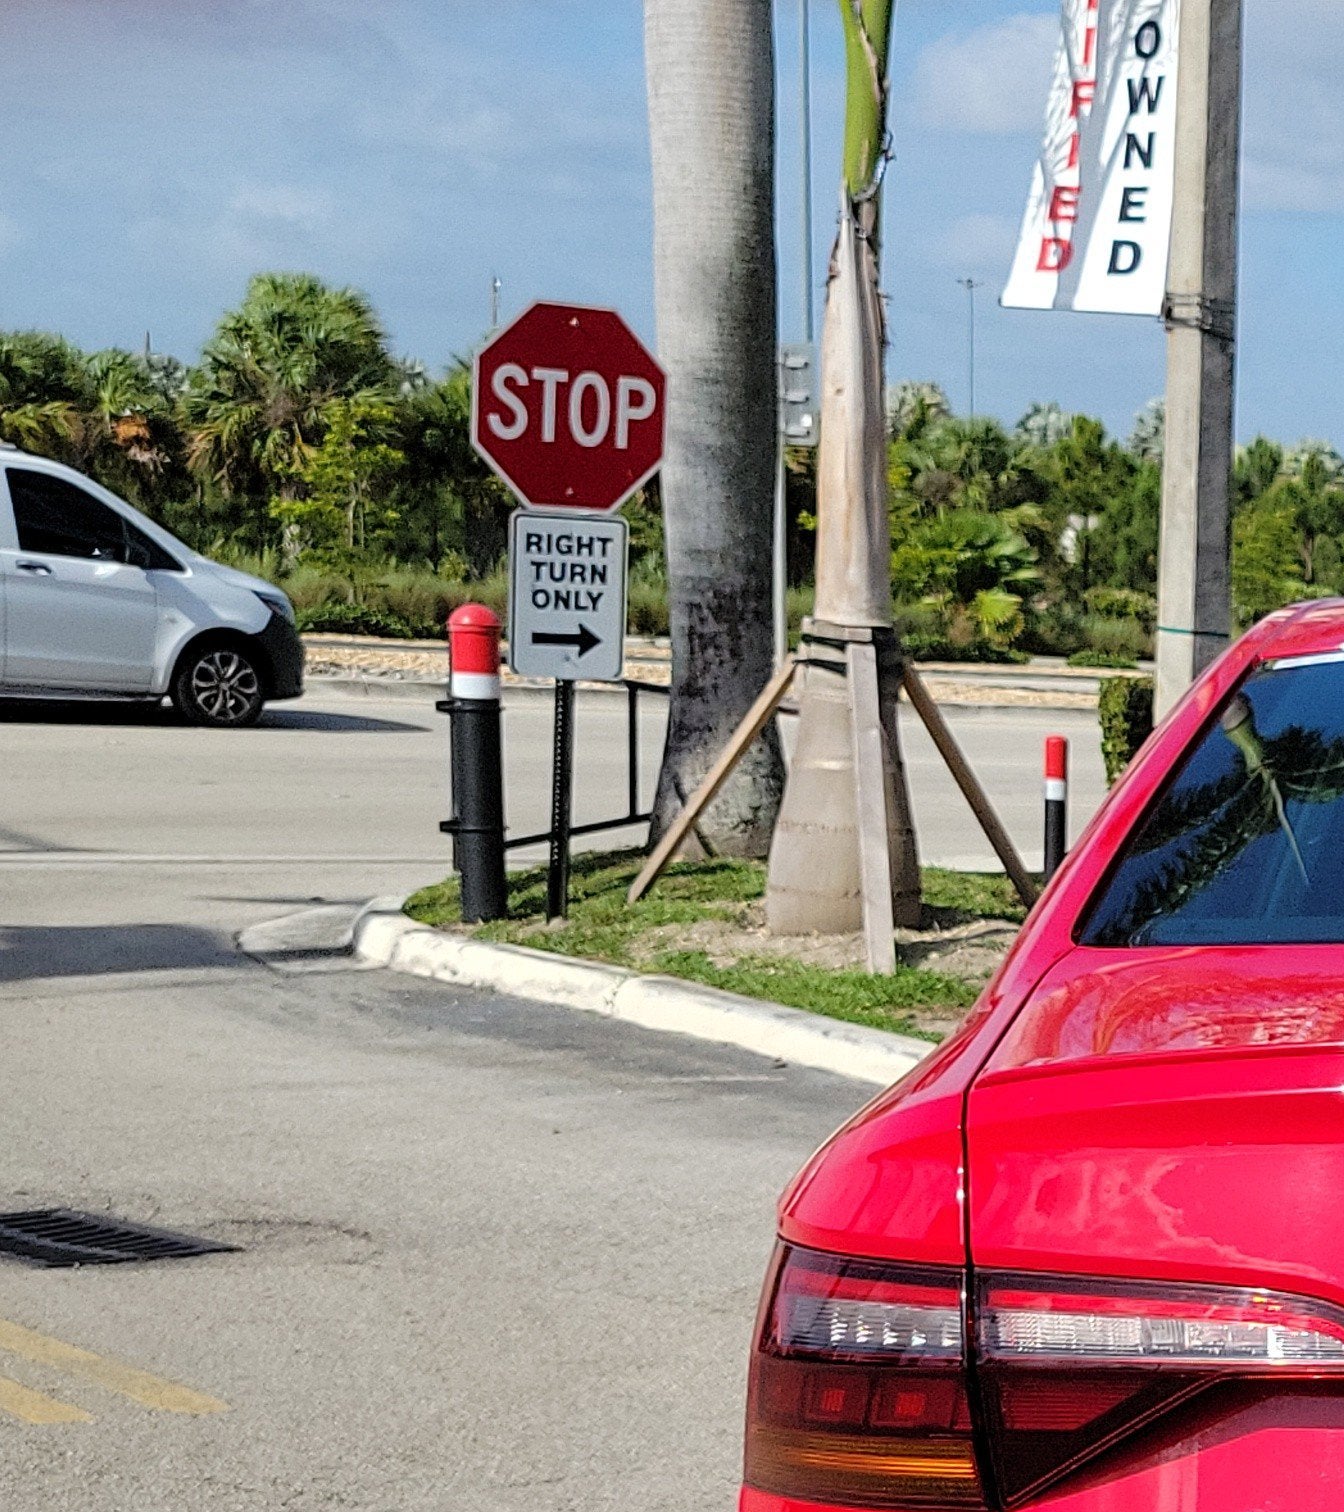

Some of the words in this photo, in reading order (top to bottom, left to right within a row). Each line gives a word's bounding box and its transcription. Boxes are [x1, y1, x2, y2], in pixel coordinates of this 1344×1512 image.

[1035, 0, 1098, 273] IFIED
[1106, 20, 1166, 276] OWNED
[487, 363, 657, 450] STOP
[525, 532, 614, 557] RIGHT
[531, 561, 607, 585] TURN
[531, 589, 605, 613] ONLY
